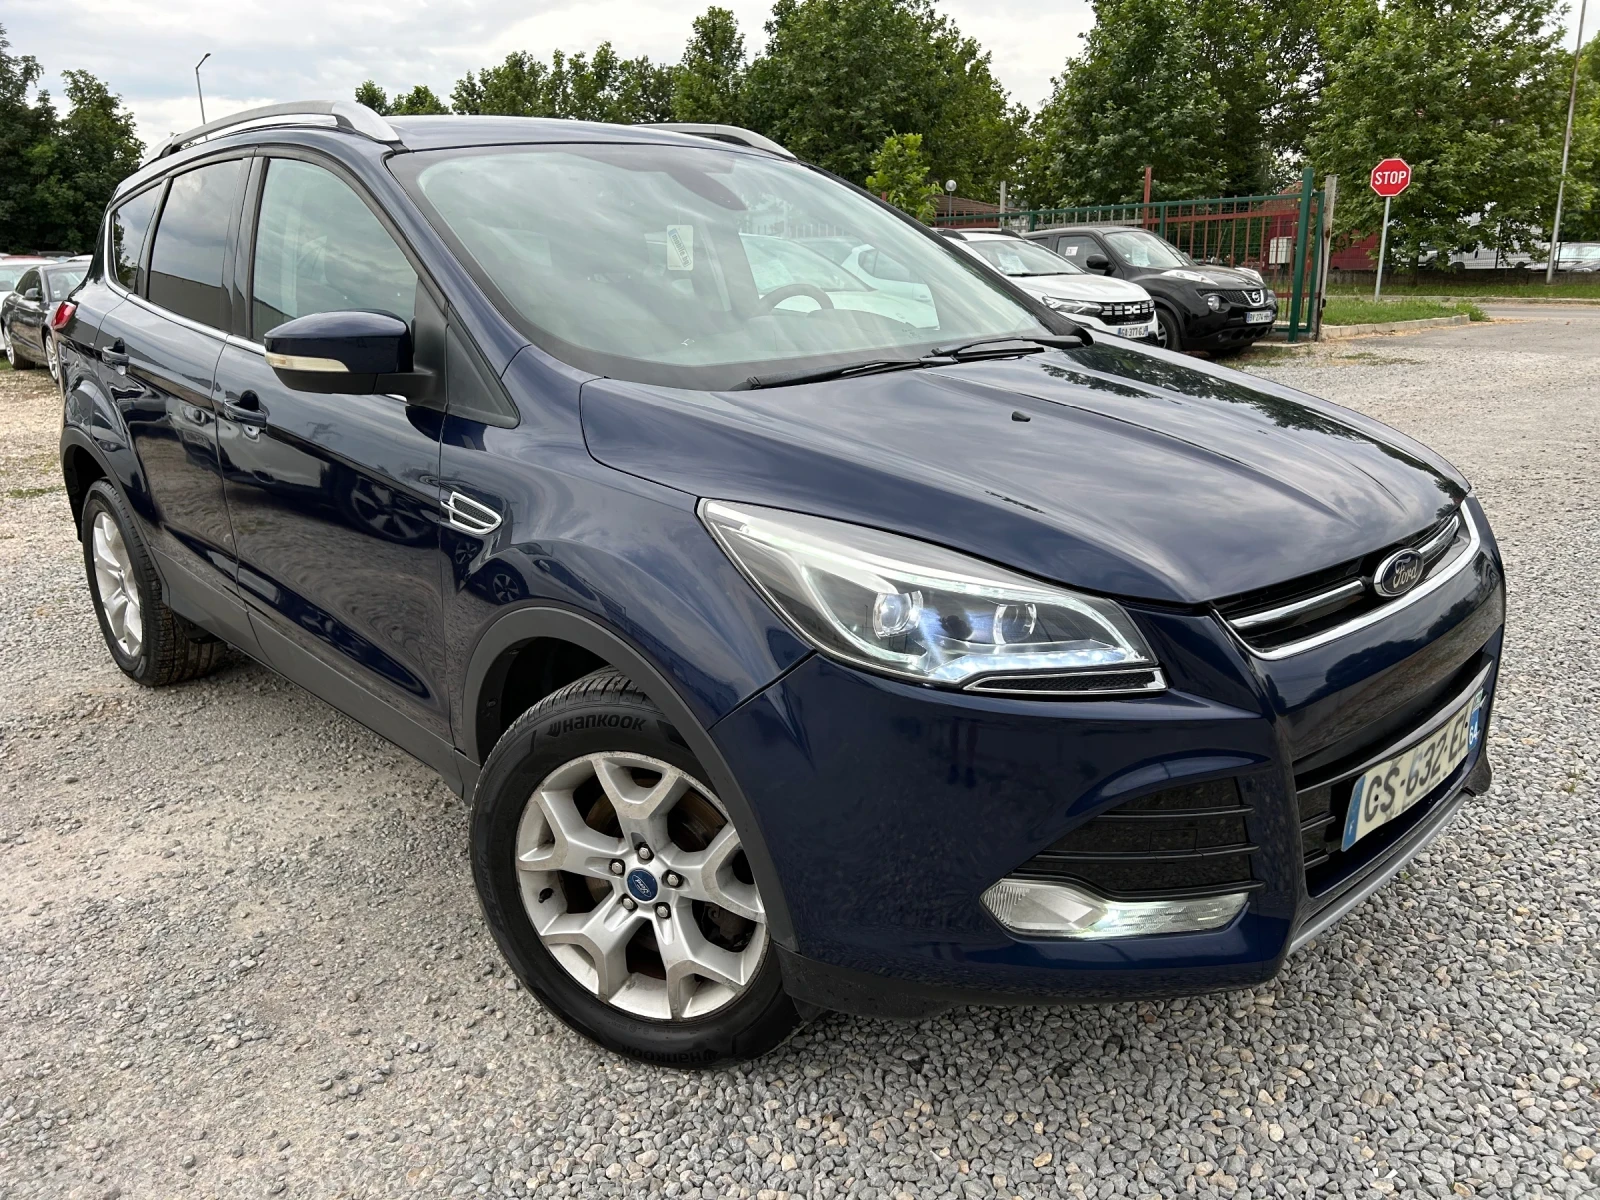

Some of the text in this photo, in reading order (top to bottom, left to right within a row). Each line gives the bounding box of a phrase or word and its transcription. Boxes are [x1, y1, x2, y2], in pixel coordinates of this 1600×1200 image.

[1375, 170, 1407, 185] STOP
[672, 233, 690, 266] mobile.bg
[1392, 556, 1418, 589] Ford
[1468, 721, 1479, 745] 64
